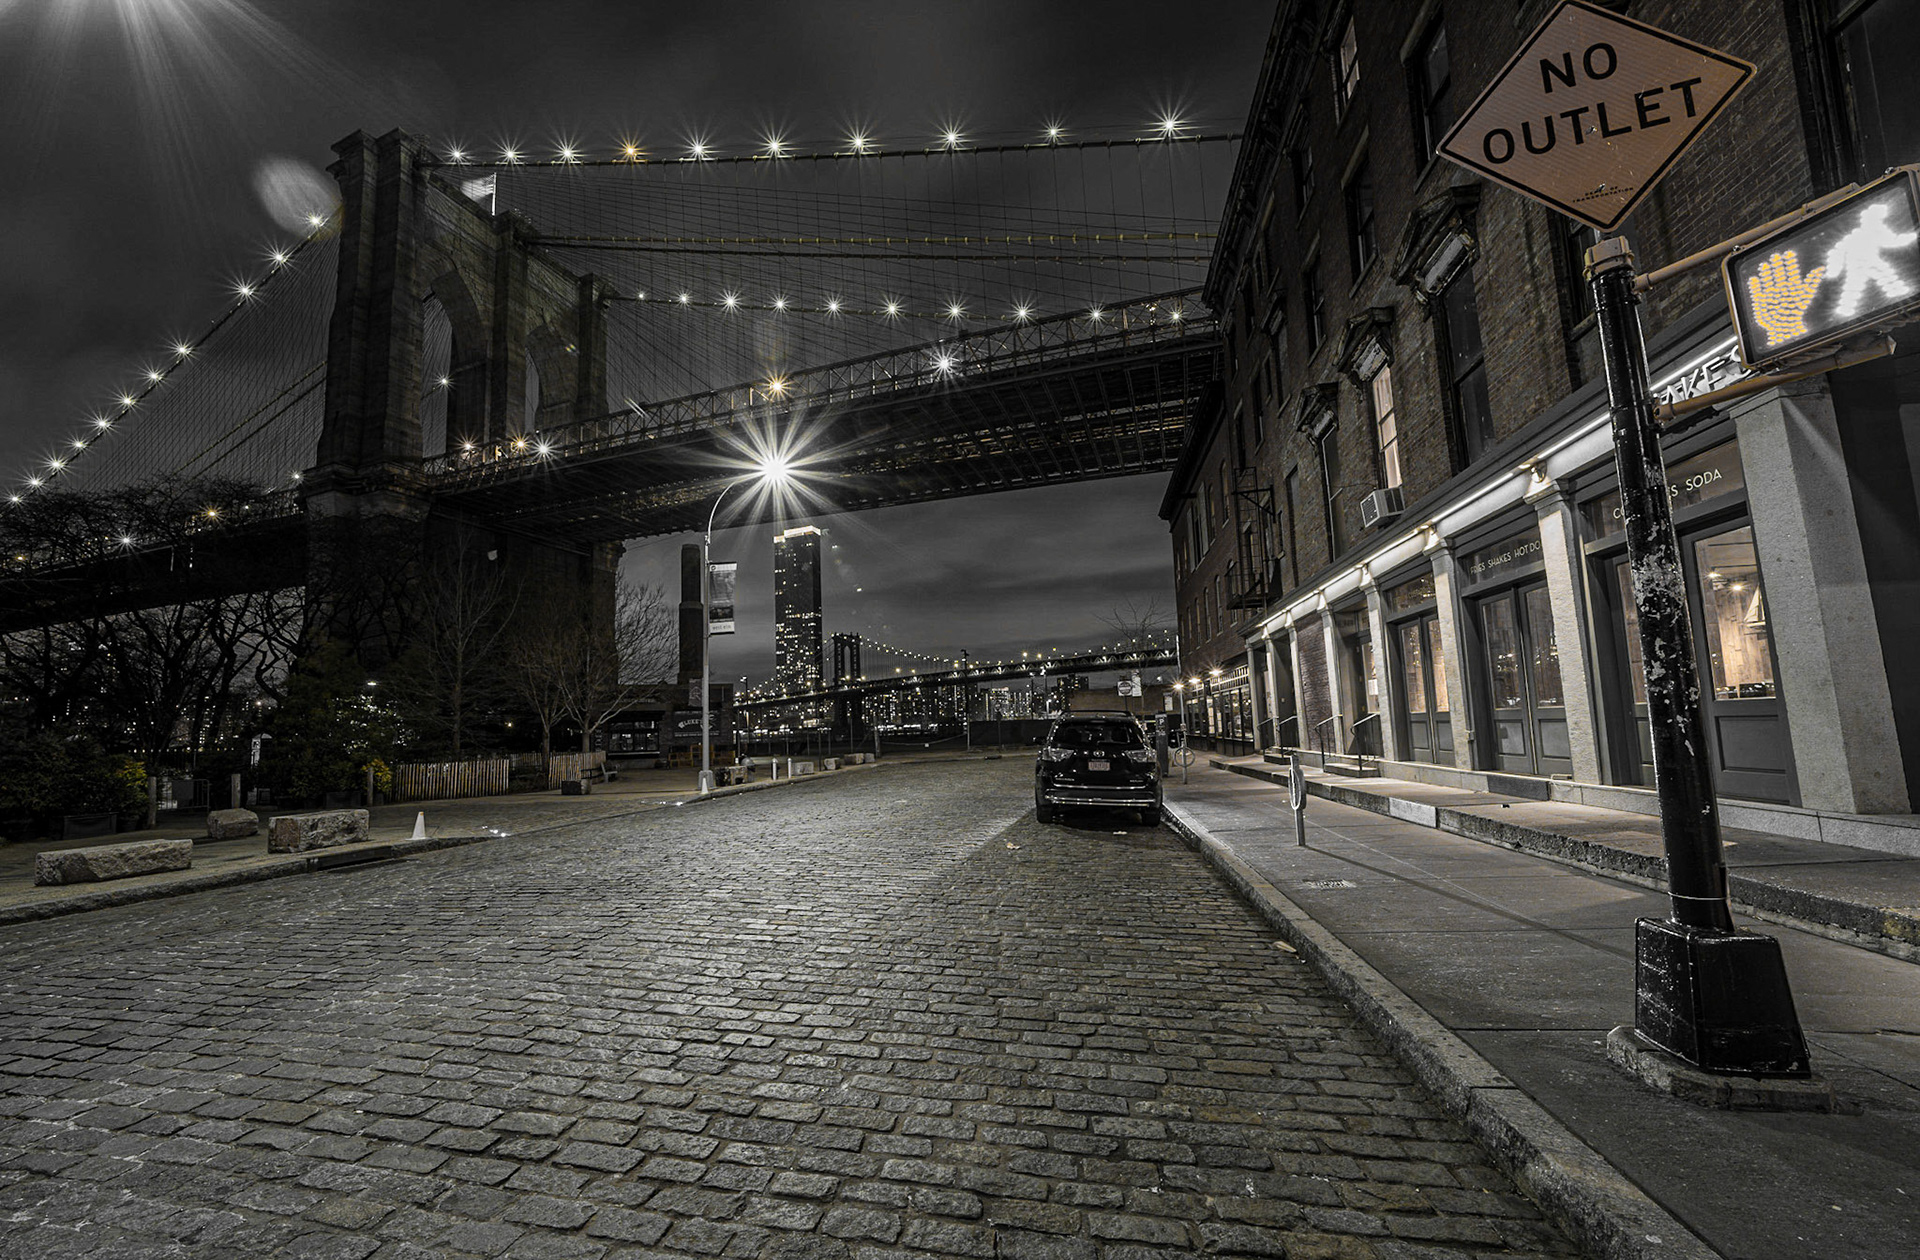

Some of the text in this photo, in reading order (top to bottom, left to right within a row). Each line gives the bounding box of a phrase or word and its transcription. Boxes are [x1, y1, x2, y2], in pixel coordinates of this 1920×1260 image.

[1539, 42, 1618, 94] NO
[1482, 76, 1702, 165] OUTLET
[1685, 468, 1722, 491] SODA
[1470, 540, 1541, 575] FRIES SHAKES HOT DO
